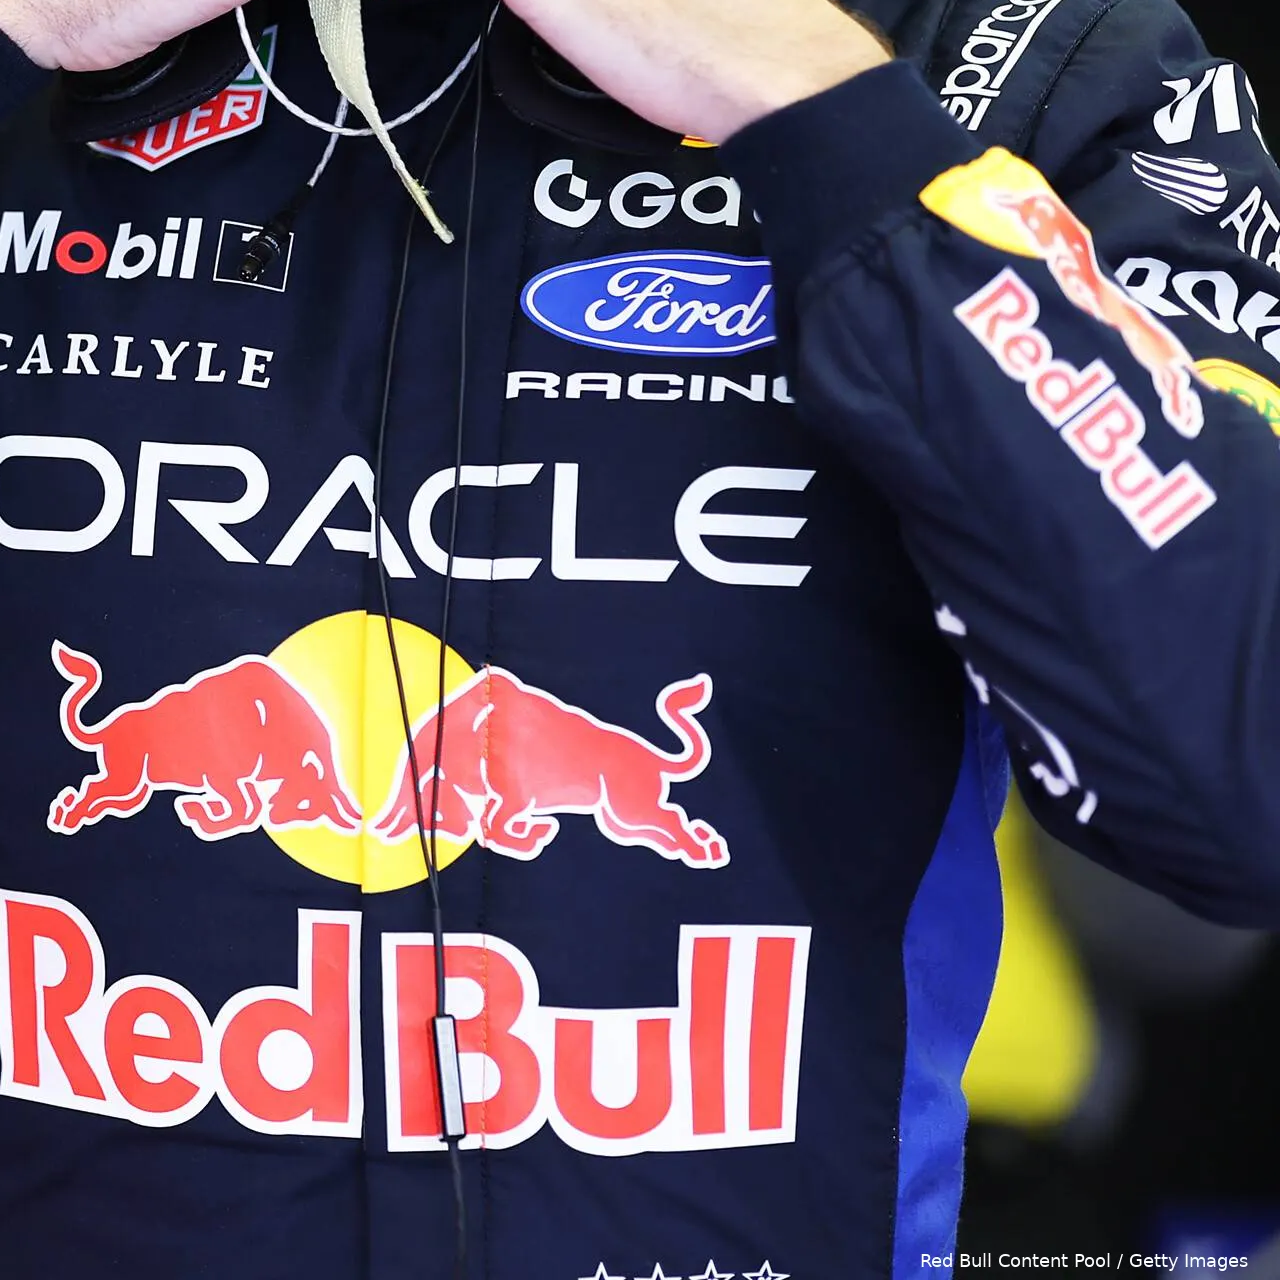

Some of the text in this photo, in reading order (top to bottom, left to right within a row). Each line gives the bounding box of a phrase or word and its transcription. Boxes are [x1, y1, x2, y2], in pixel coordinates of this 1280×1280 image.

[121, 94, 255, 158] UER
[609, 171, 761, 229] Ga
[584, 266, 772, 337] Ford
[1115, 257, 1280, 363] ROK
[959, 273, 1210, 543] Red Bull
[389, 930, 804, 1148] Bull
